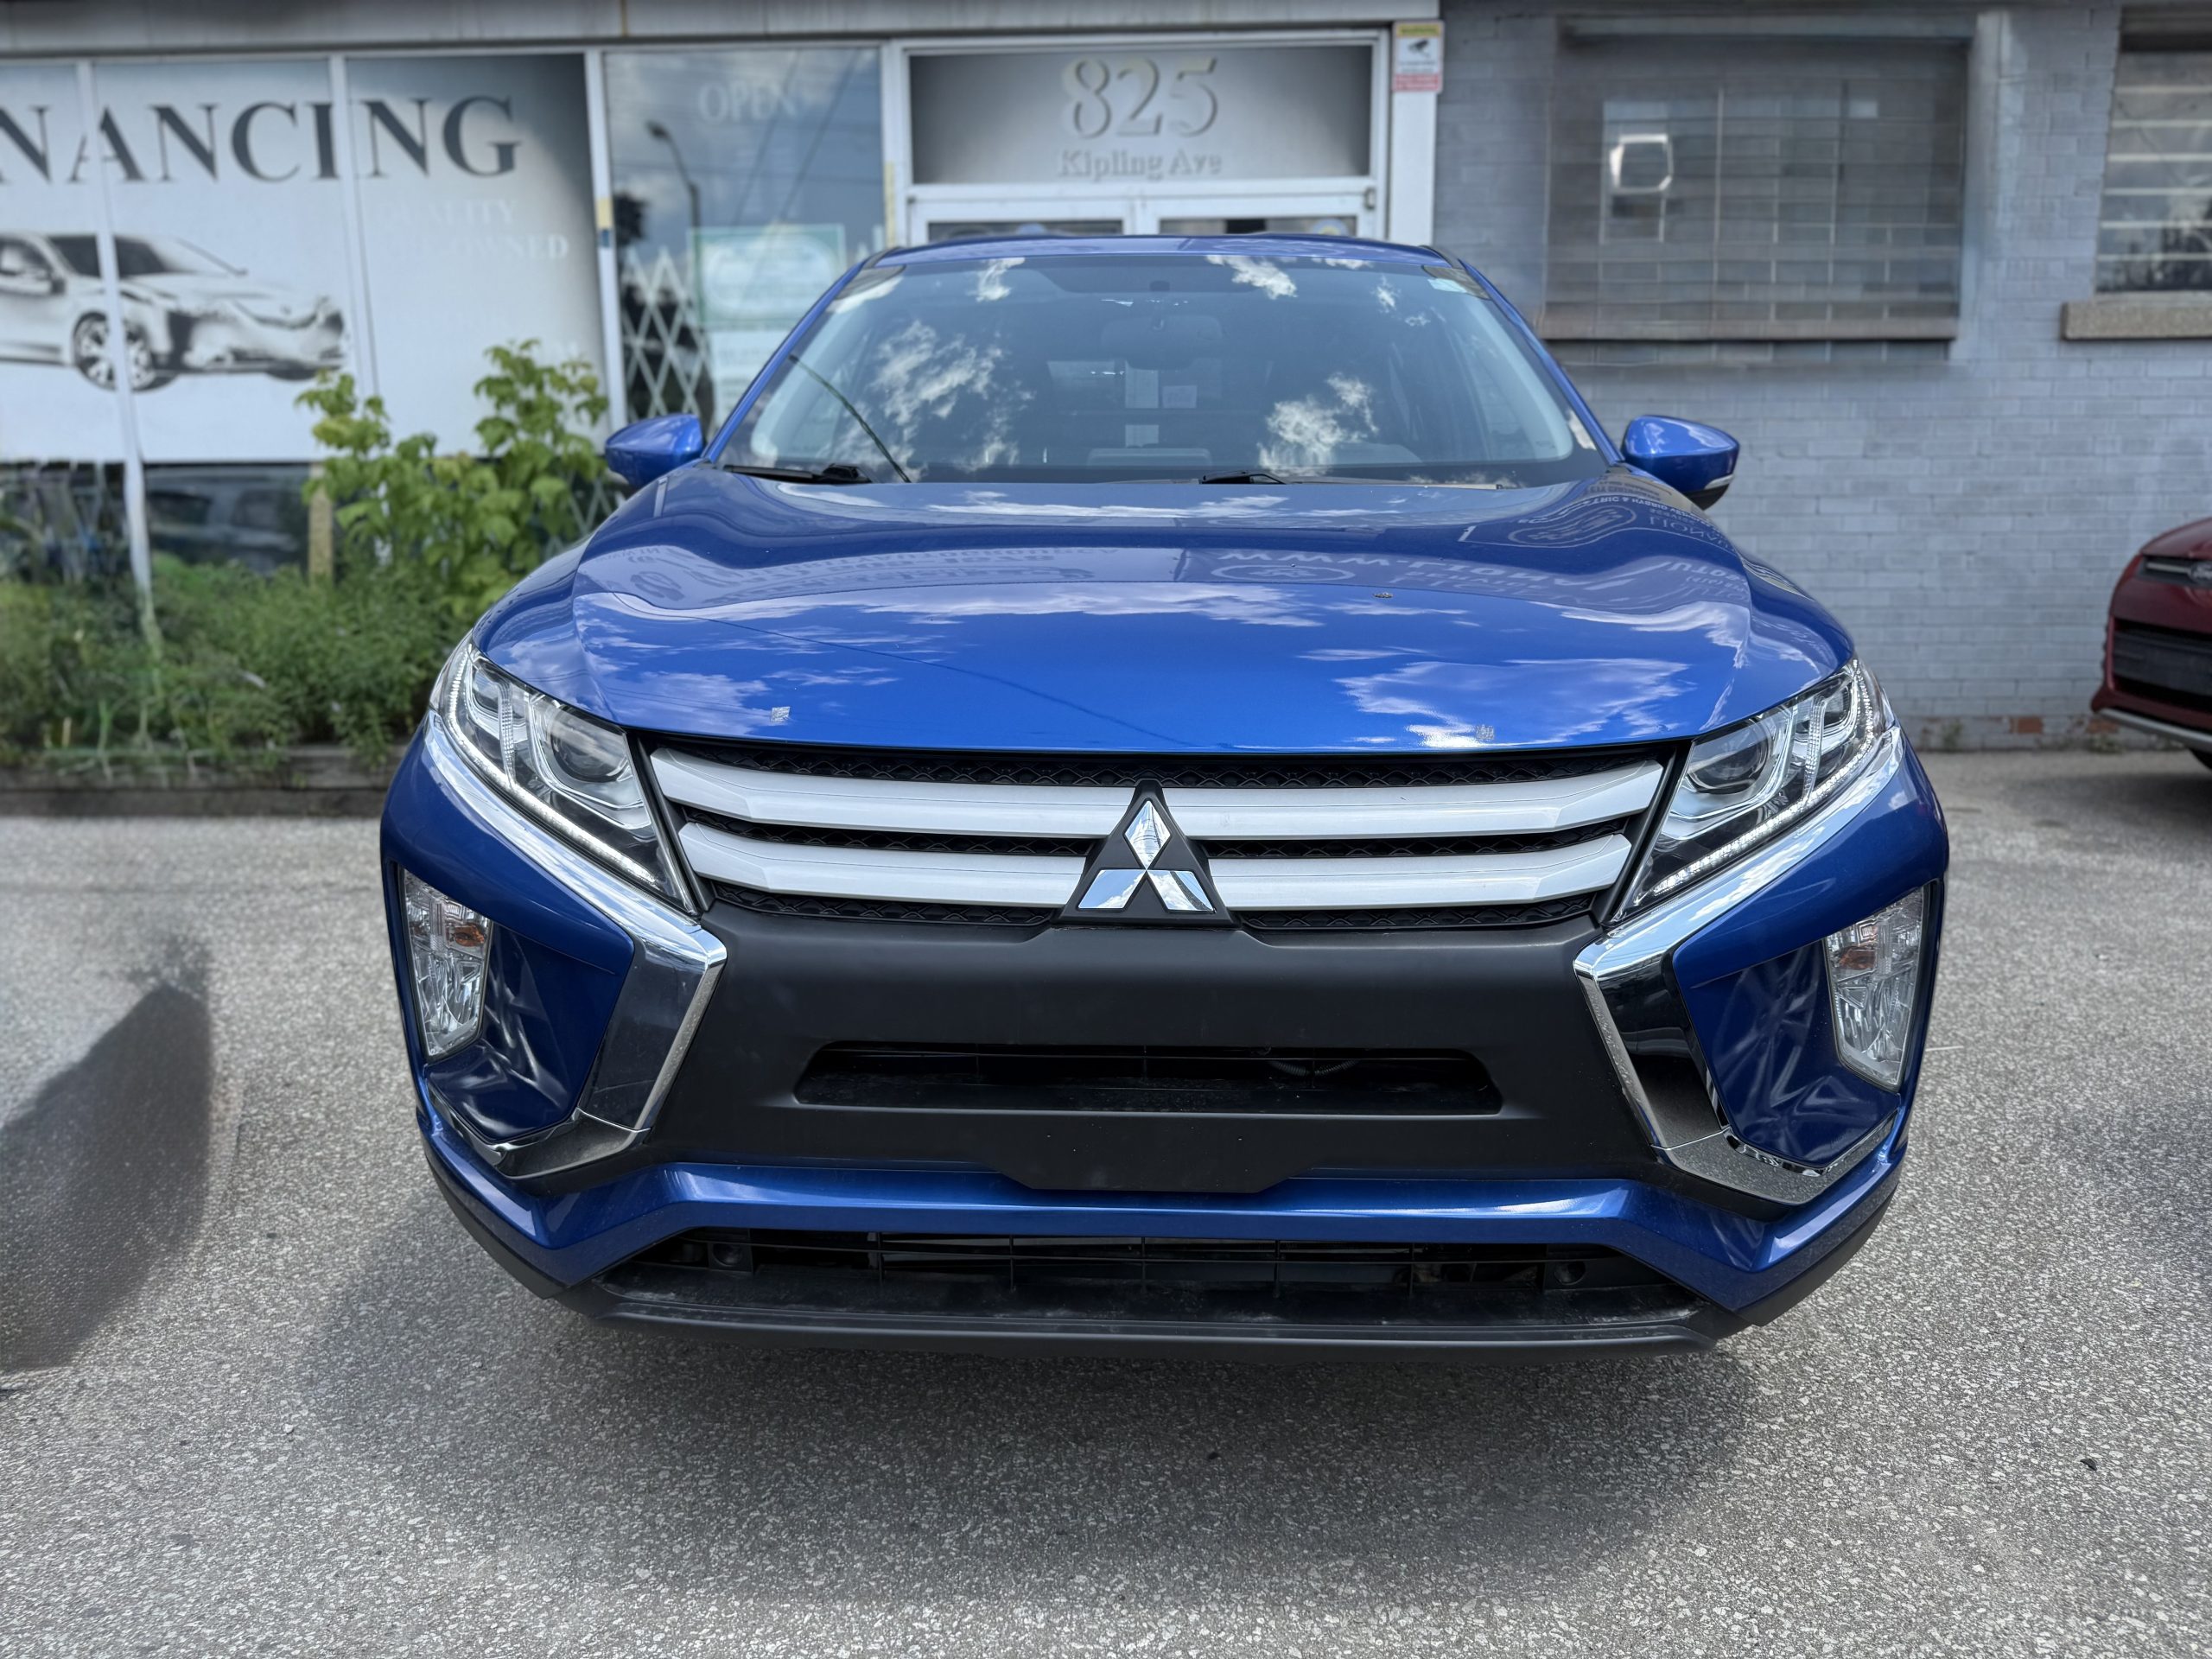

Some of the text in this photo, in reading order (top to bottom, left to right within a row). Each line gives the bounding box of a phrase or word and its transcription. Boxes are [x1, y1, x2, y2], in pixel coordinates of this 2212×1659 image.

[1062, 56, 1218, 140] 825
[1059, 149, 1223, 181] Kipling Ave
[378, 199, 518, 226] ALITY
